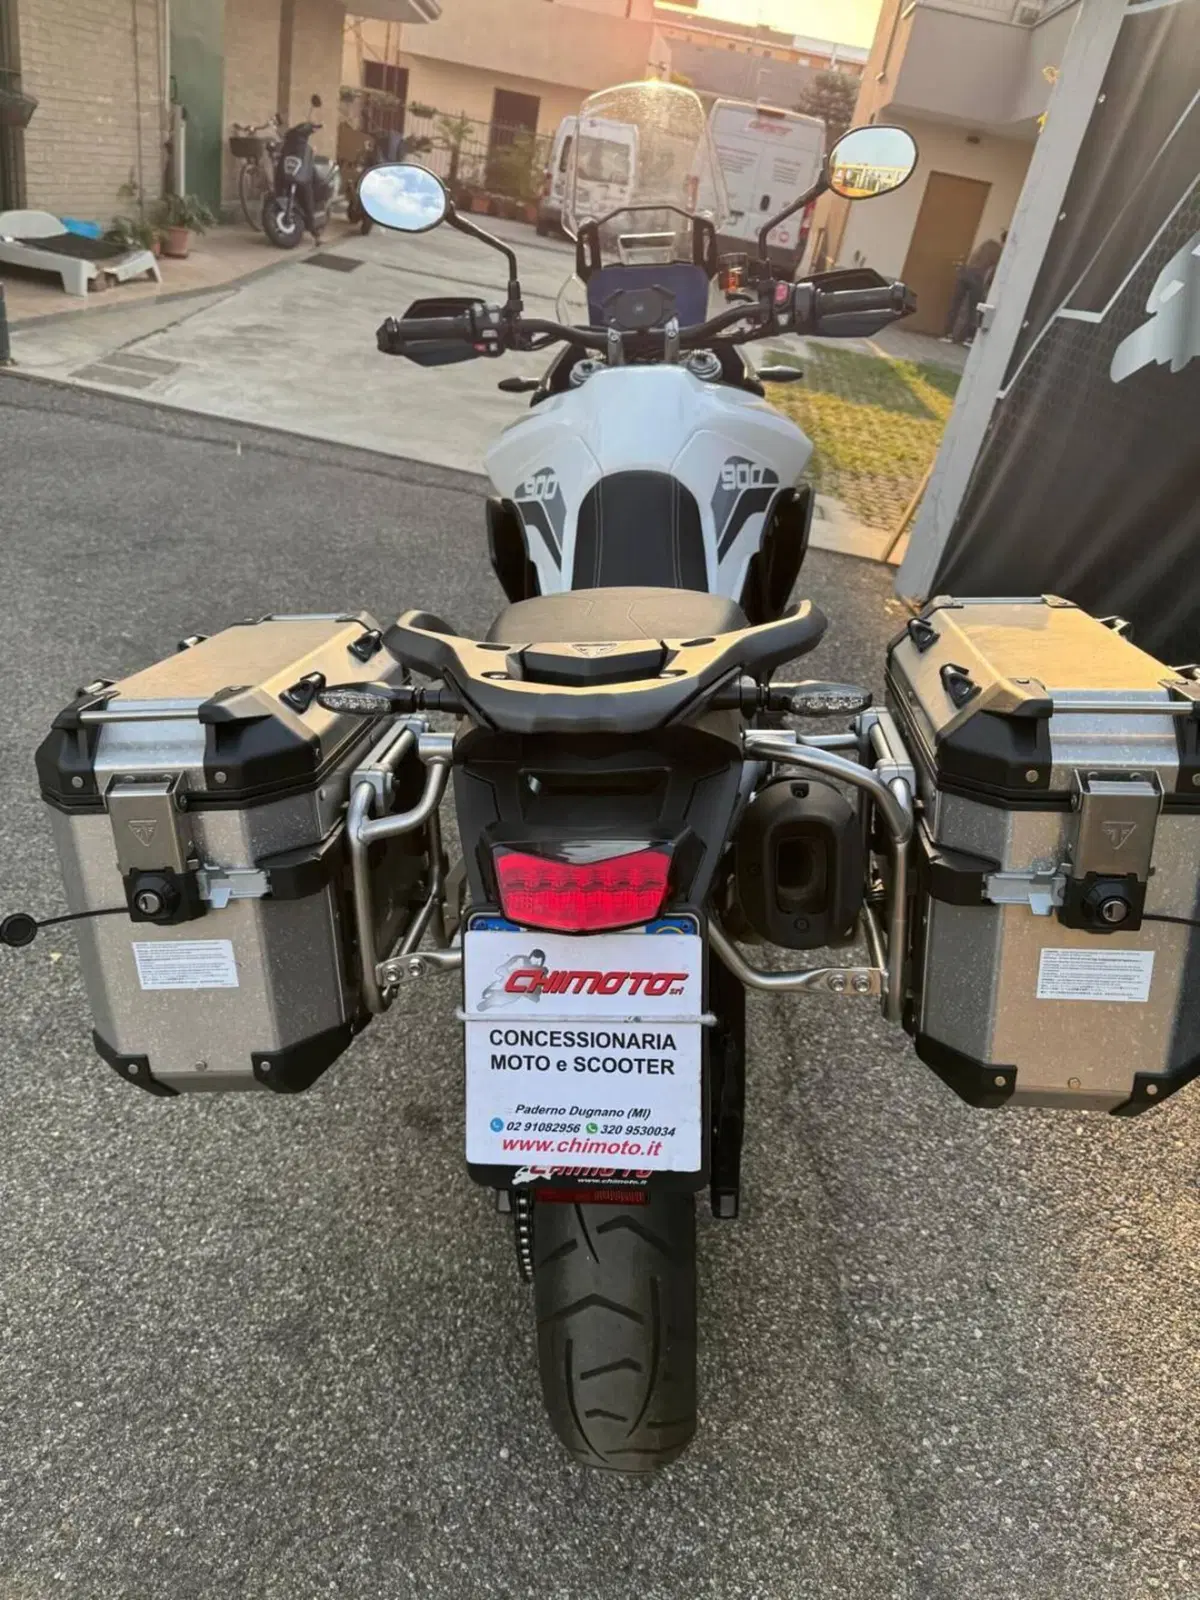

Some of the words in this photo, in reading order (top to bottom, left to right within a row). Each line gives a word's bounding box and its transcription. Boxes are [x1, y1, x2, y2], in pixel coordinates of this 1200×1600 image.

[721, 463, 765, 491] 900
[504, 970, 688, 996] CHIMOTO
[489, 1029, 677, 1051] CONCESSIONARIA
[490, 1054, 551, 1072] MOTO
[556, 1060, 567, 1072] e
[573, 1056, 675, 1075] SCOOTER
[515, 1104, 566, 1116] Paderno
[569, 1105, 624, 1119] Dugnano
[627, 1107, 651, 1120] (MI)
[506, 1122, 522, 1132] 02
[524, 1122, 581, 1133] 91082956
[600, 1125, 622, 1135] 320
[625, 1126, 676, 1137] 9530034
[502, 1136, 662, 1157] www.chimoto.it
